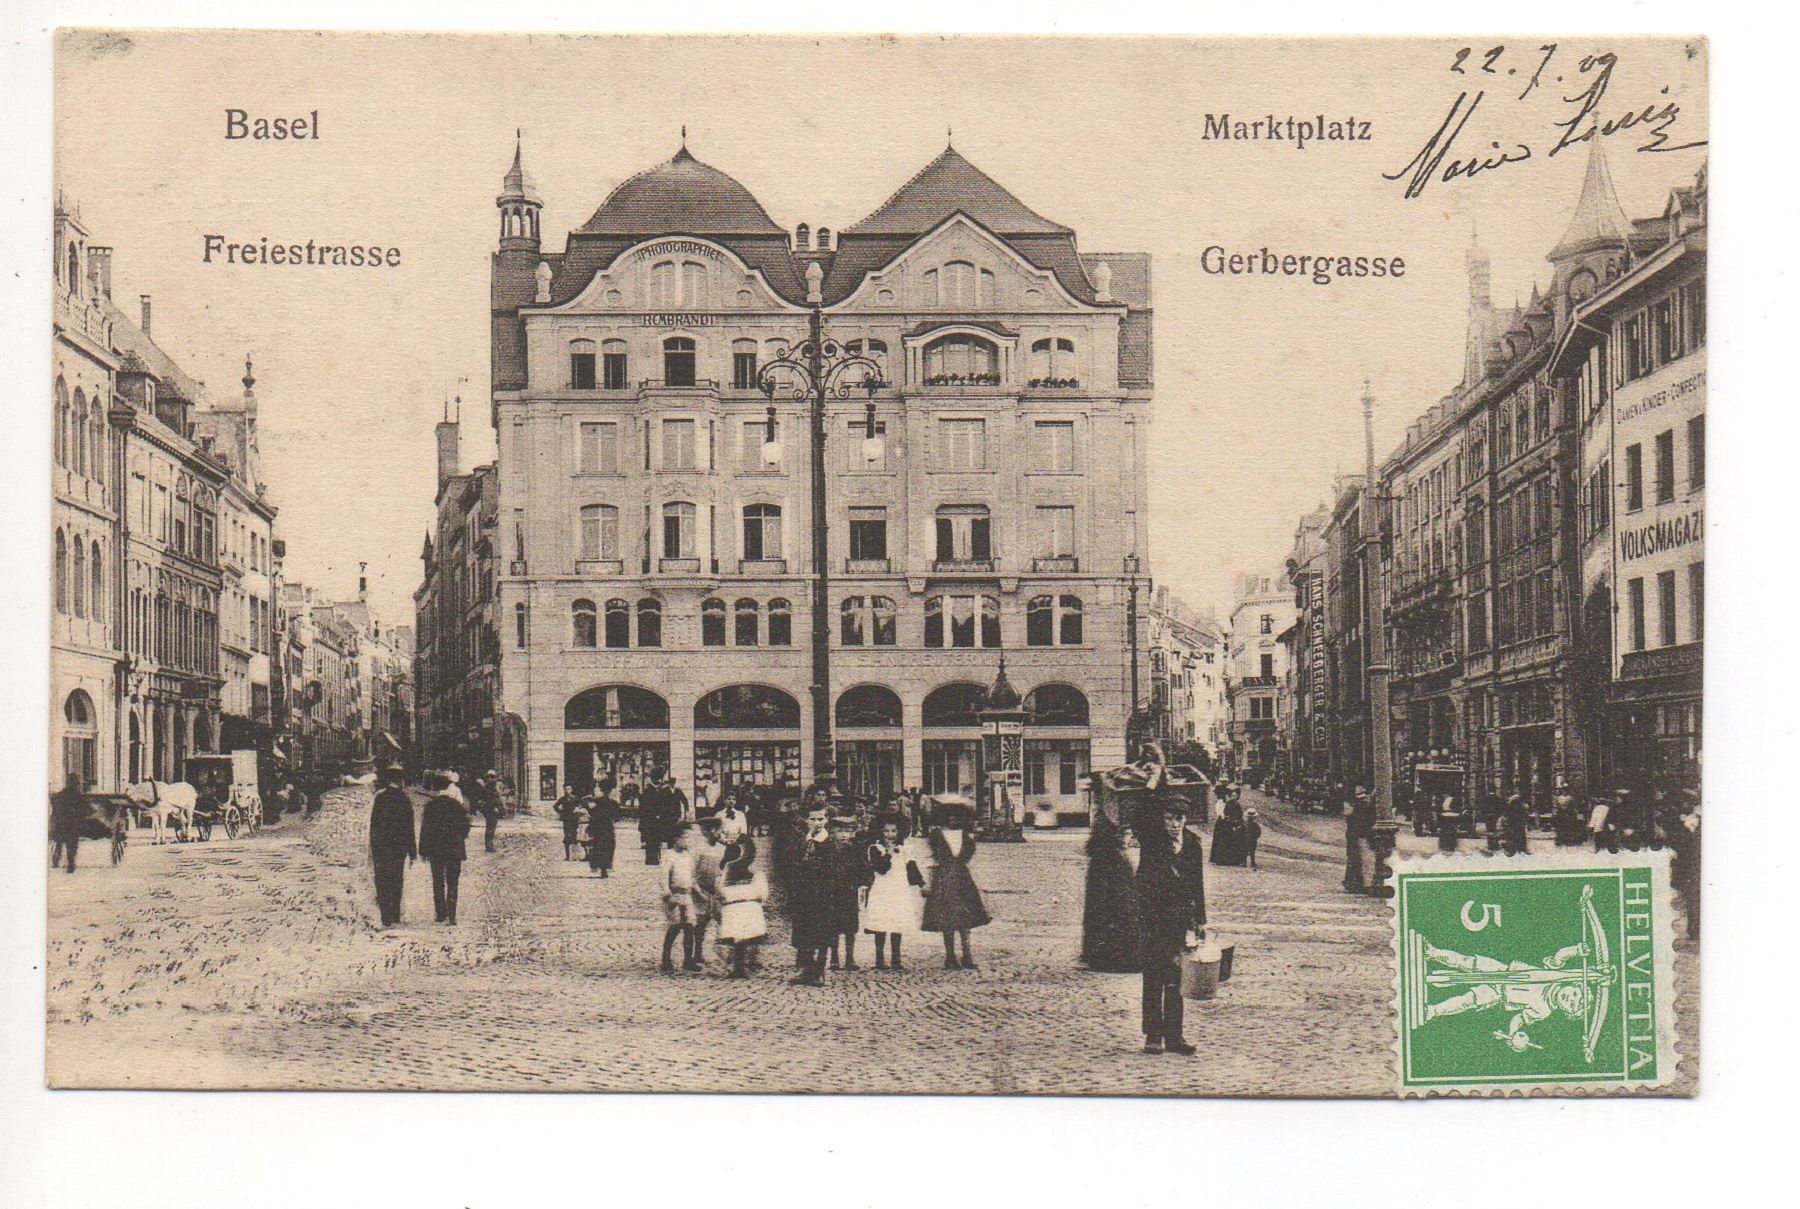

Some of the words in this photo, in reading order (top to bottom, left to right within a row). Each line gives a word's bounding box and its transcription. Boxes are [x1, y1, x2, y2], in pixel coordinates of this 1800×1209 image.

[1382, 90, 1531, 199] Marie
[1311, 577, 1323, 610] HANS
[1312, 614, 1326, 707] SCHNEEBERGER
[1461, 900, 1502, 932] 5
[1625, 883, 1654, 1071] HELVETIA
